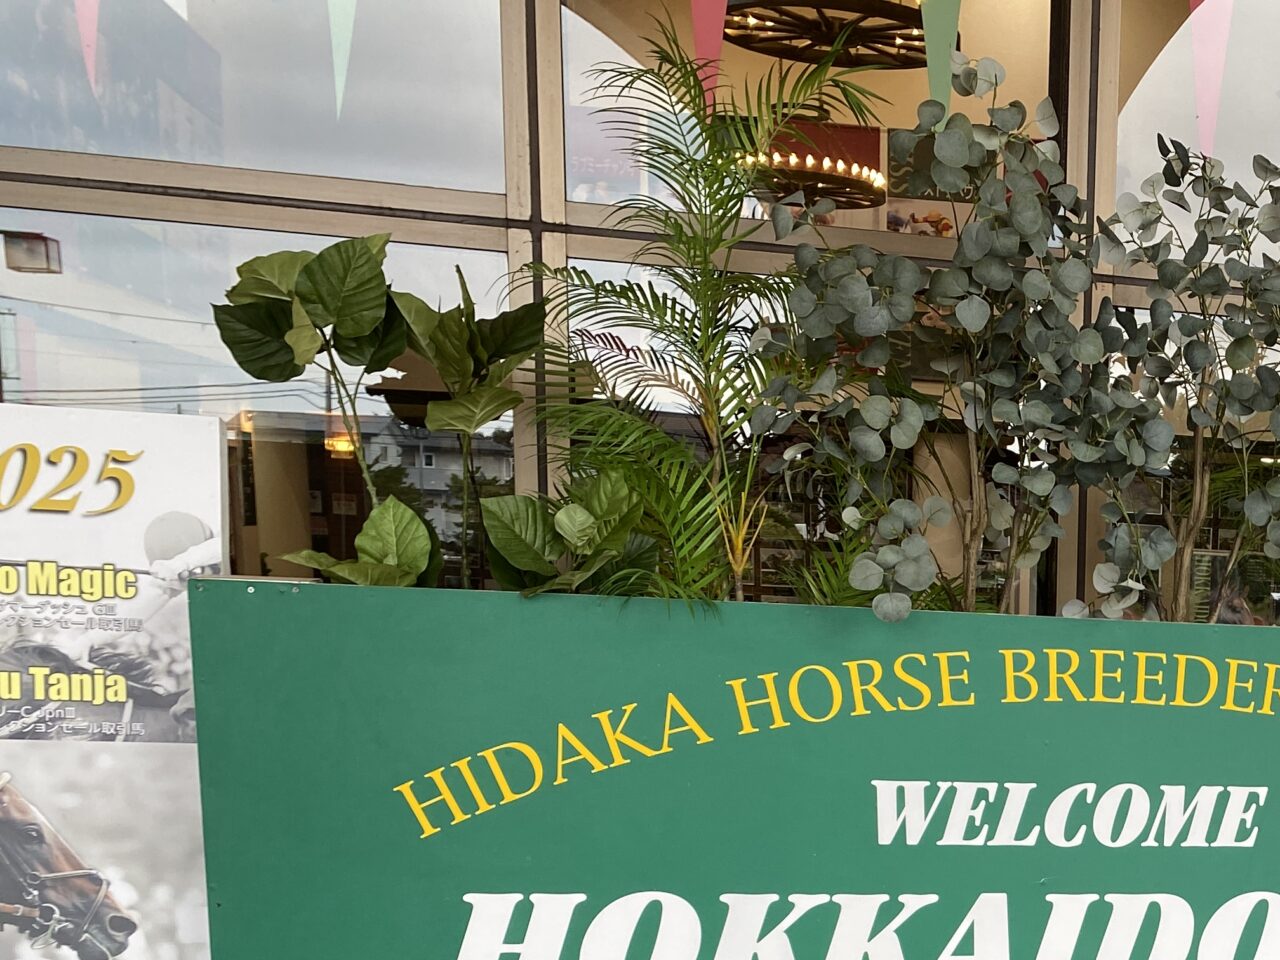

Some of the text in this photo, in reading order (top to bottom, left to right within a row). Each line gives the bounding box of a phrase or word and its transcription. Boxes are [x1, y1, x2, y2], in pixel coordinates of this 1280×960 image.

[26, 560, 138, 602] Magic
[28, 666, 128, 705] Tanja
[393, 692, 714, 839] HIDAKA
[725, 650, 975, 736] HORSE
[870, 779, 1269, 848] WELCOME
